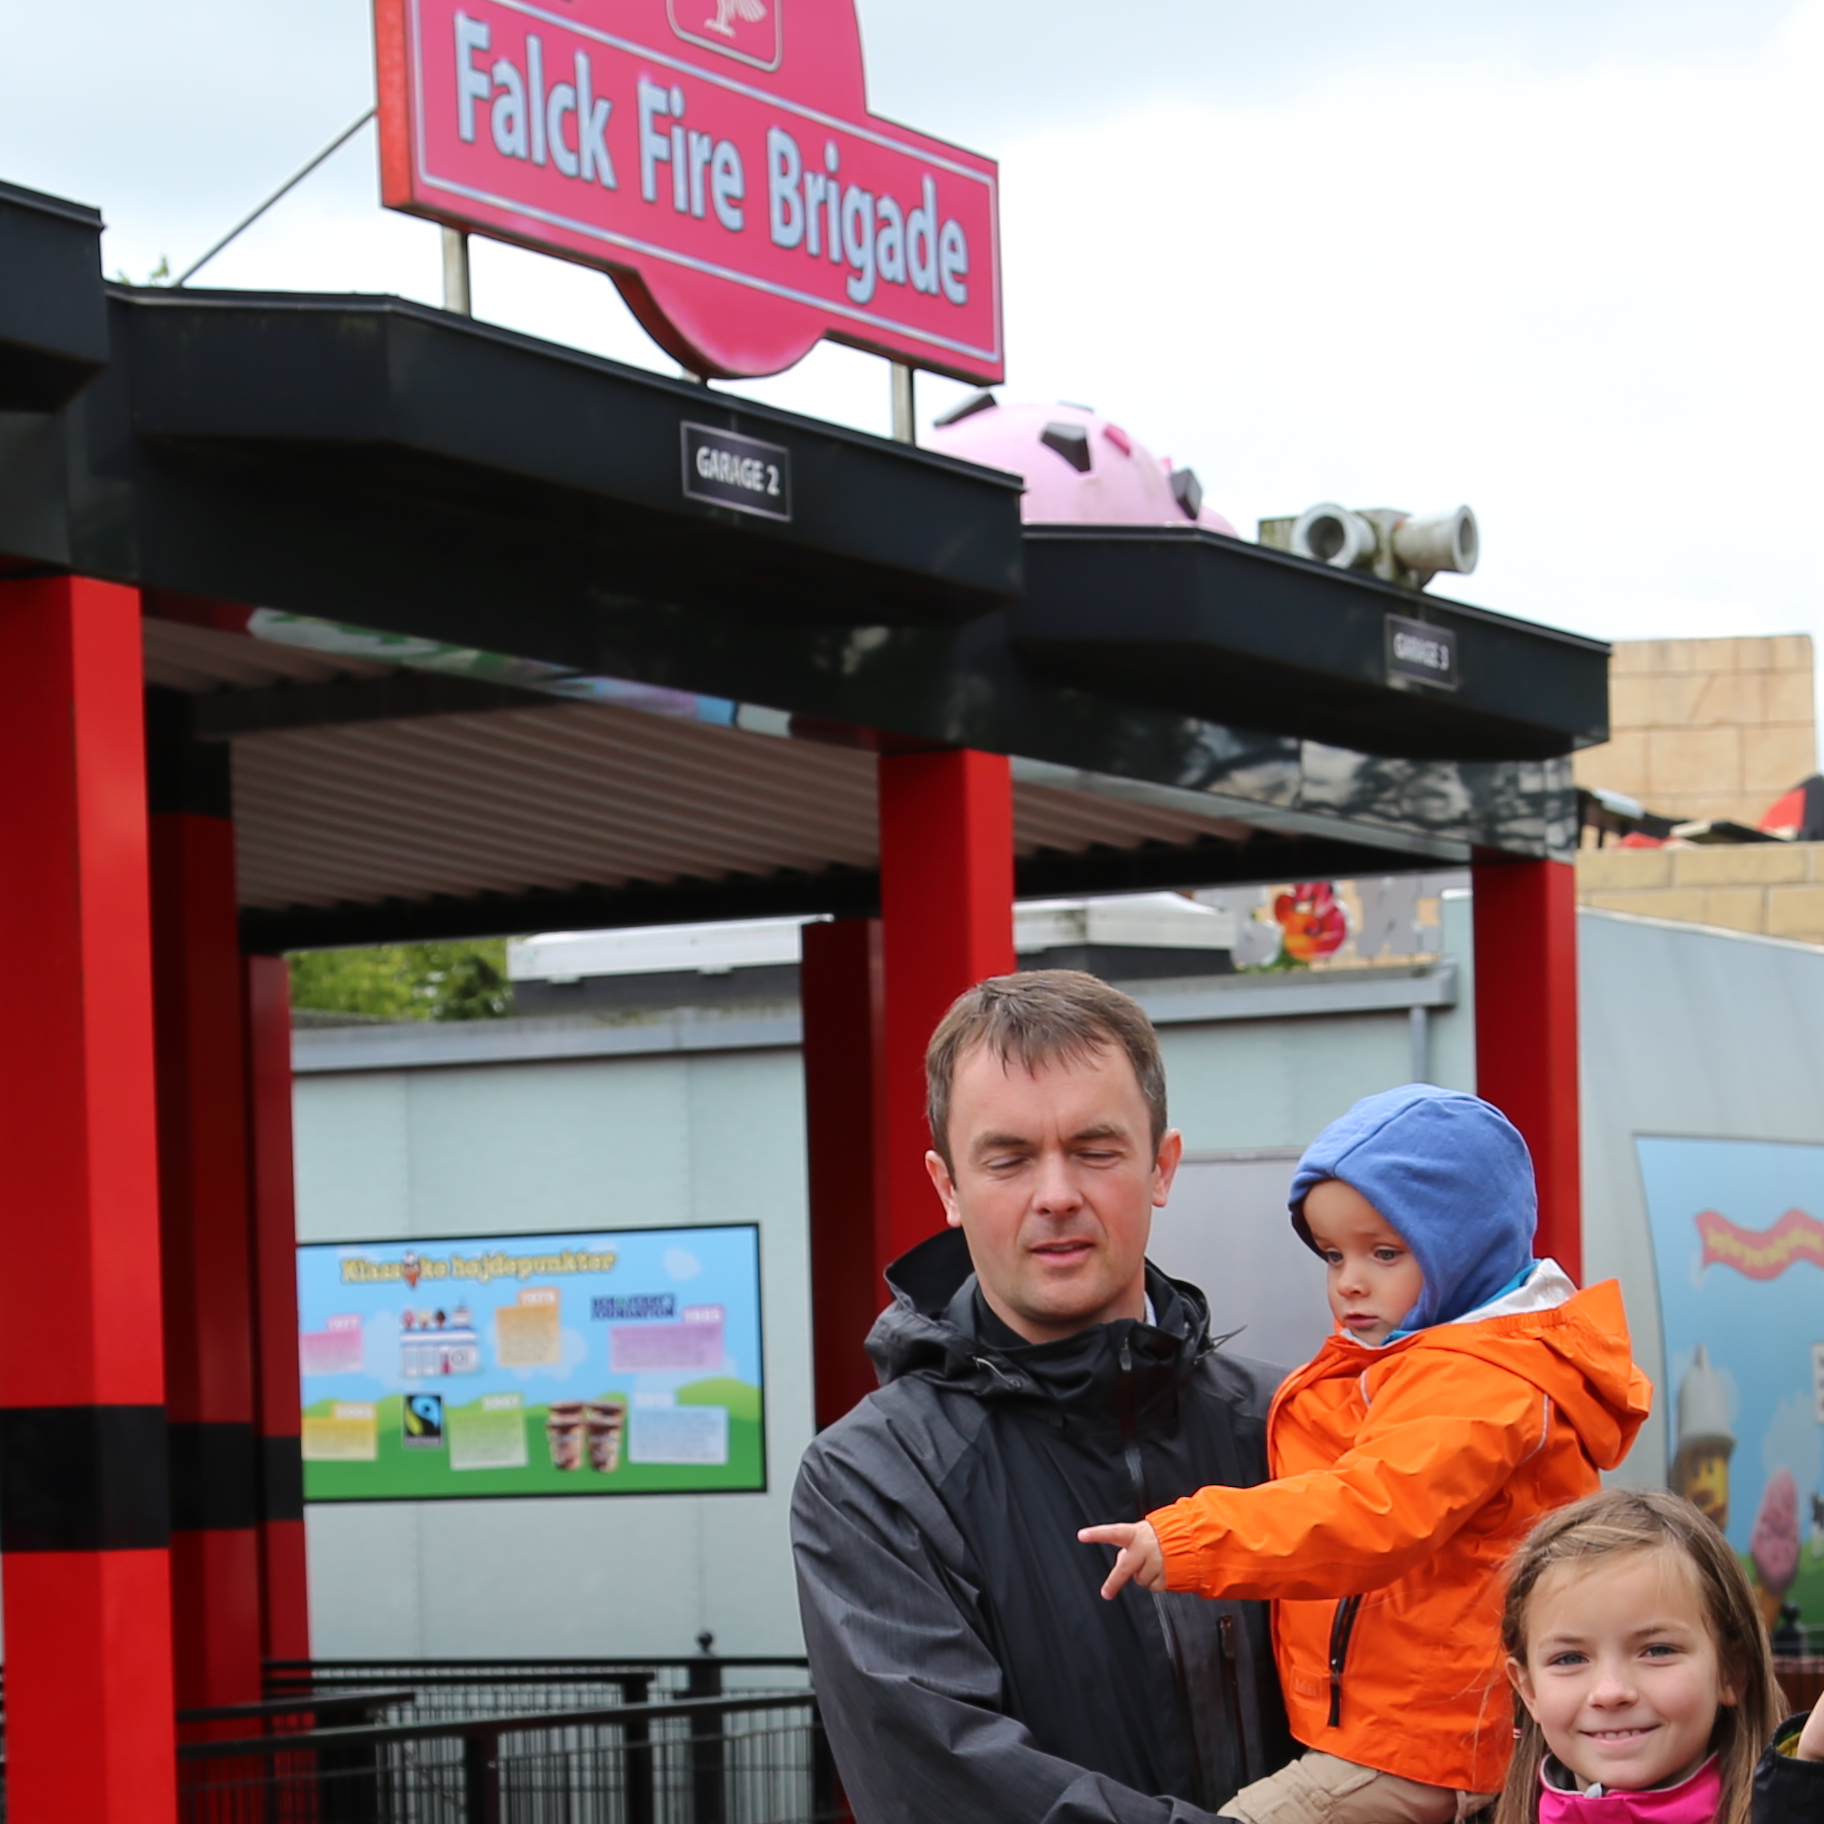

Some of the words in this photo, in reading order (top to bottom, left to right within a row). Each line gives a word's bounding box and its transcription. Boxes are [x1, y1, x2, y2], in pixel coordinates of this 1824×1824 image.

[454, 14, 616, 190] Falck
[637, 76, 744, 232] Fire
[768, 126, 969, 306] Brigade
[696, 445, 765, 493] GARAGE
[766, 464, 781, 497] 2
